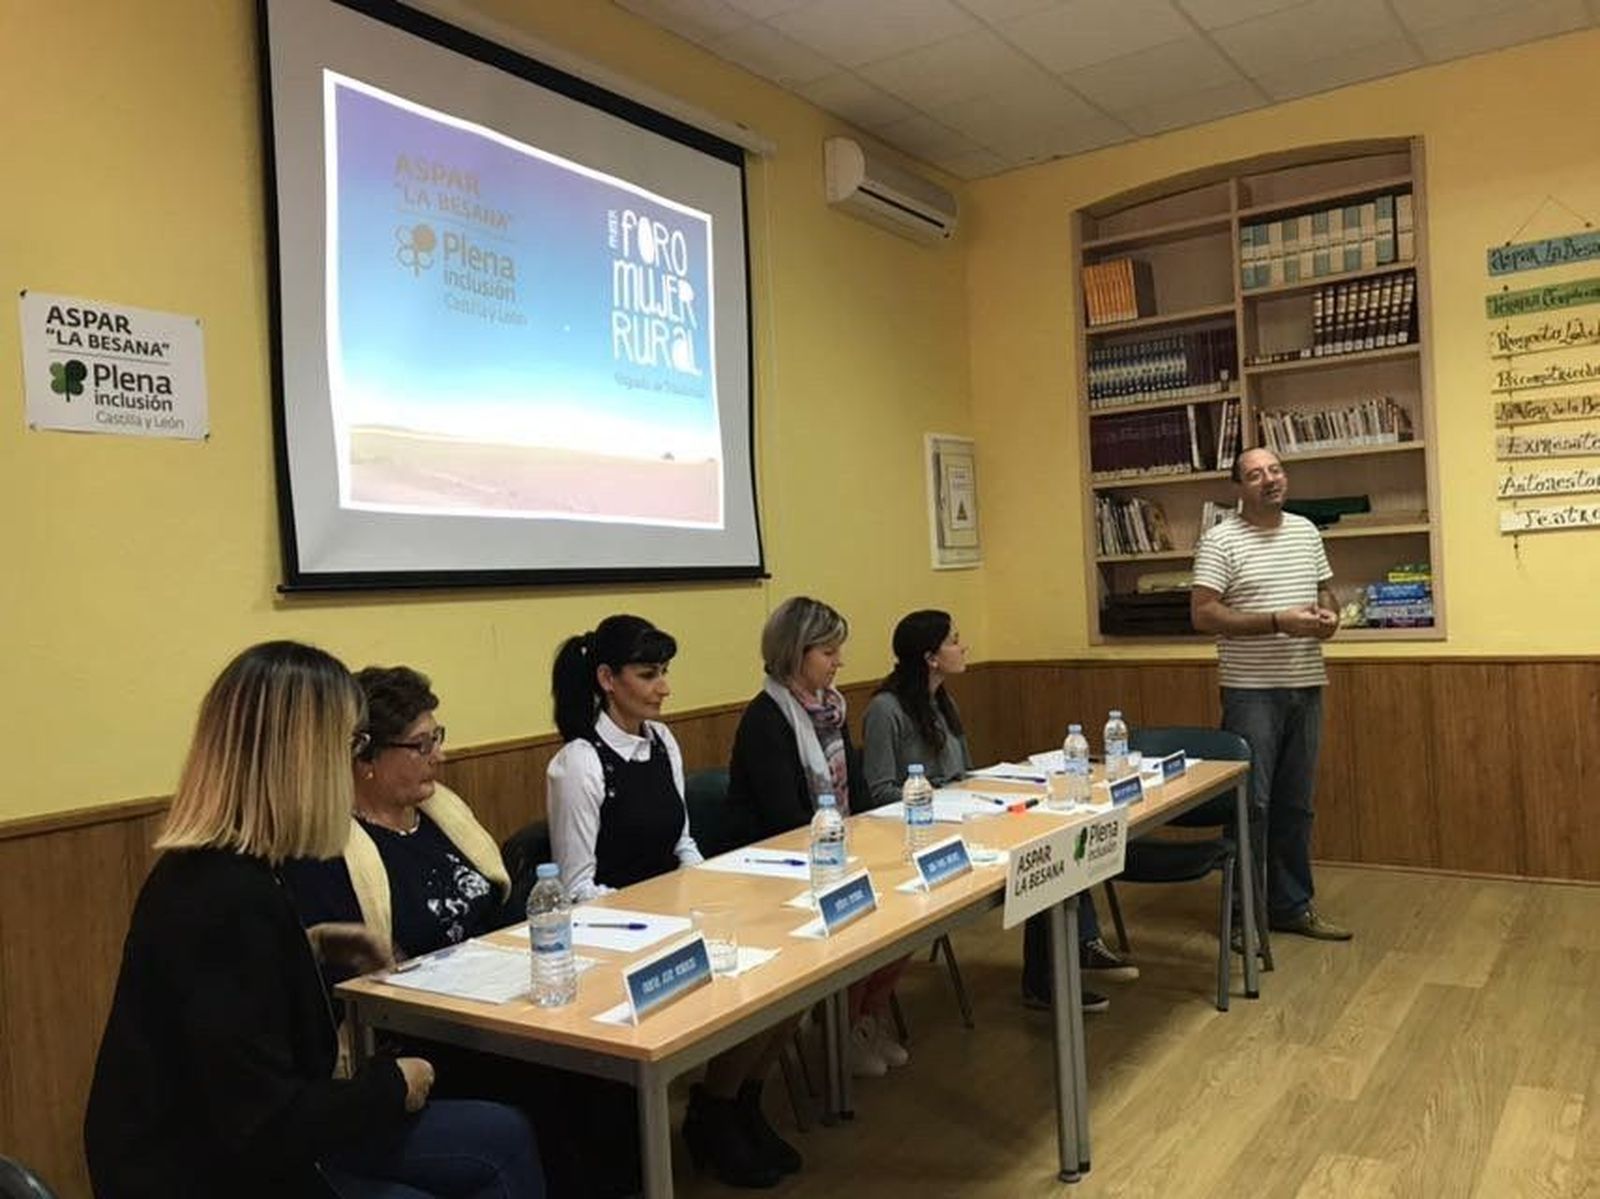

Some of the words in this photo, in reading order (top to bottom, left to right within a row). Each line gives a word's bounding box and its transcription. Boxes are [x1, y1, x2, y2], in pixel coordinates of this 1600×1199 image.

[443, 230, 516, 281] Plena
[621, 209, 688, 277] FORO
[46, 304, 132, 335] ASPAR
[93, 362, 173, 395] Plena
[94, 388, 173, 412] inclusión
[96, 409, 142, 427] Castilla
[144, 417, 152, 430] y
[154, 411, 185, 430] León
[1016, 845, 1053, 877] ASPAR
[1014, 877, 1028, 897] LA
